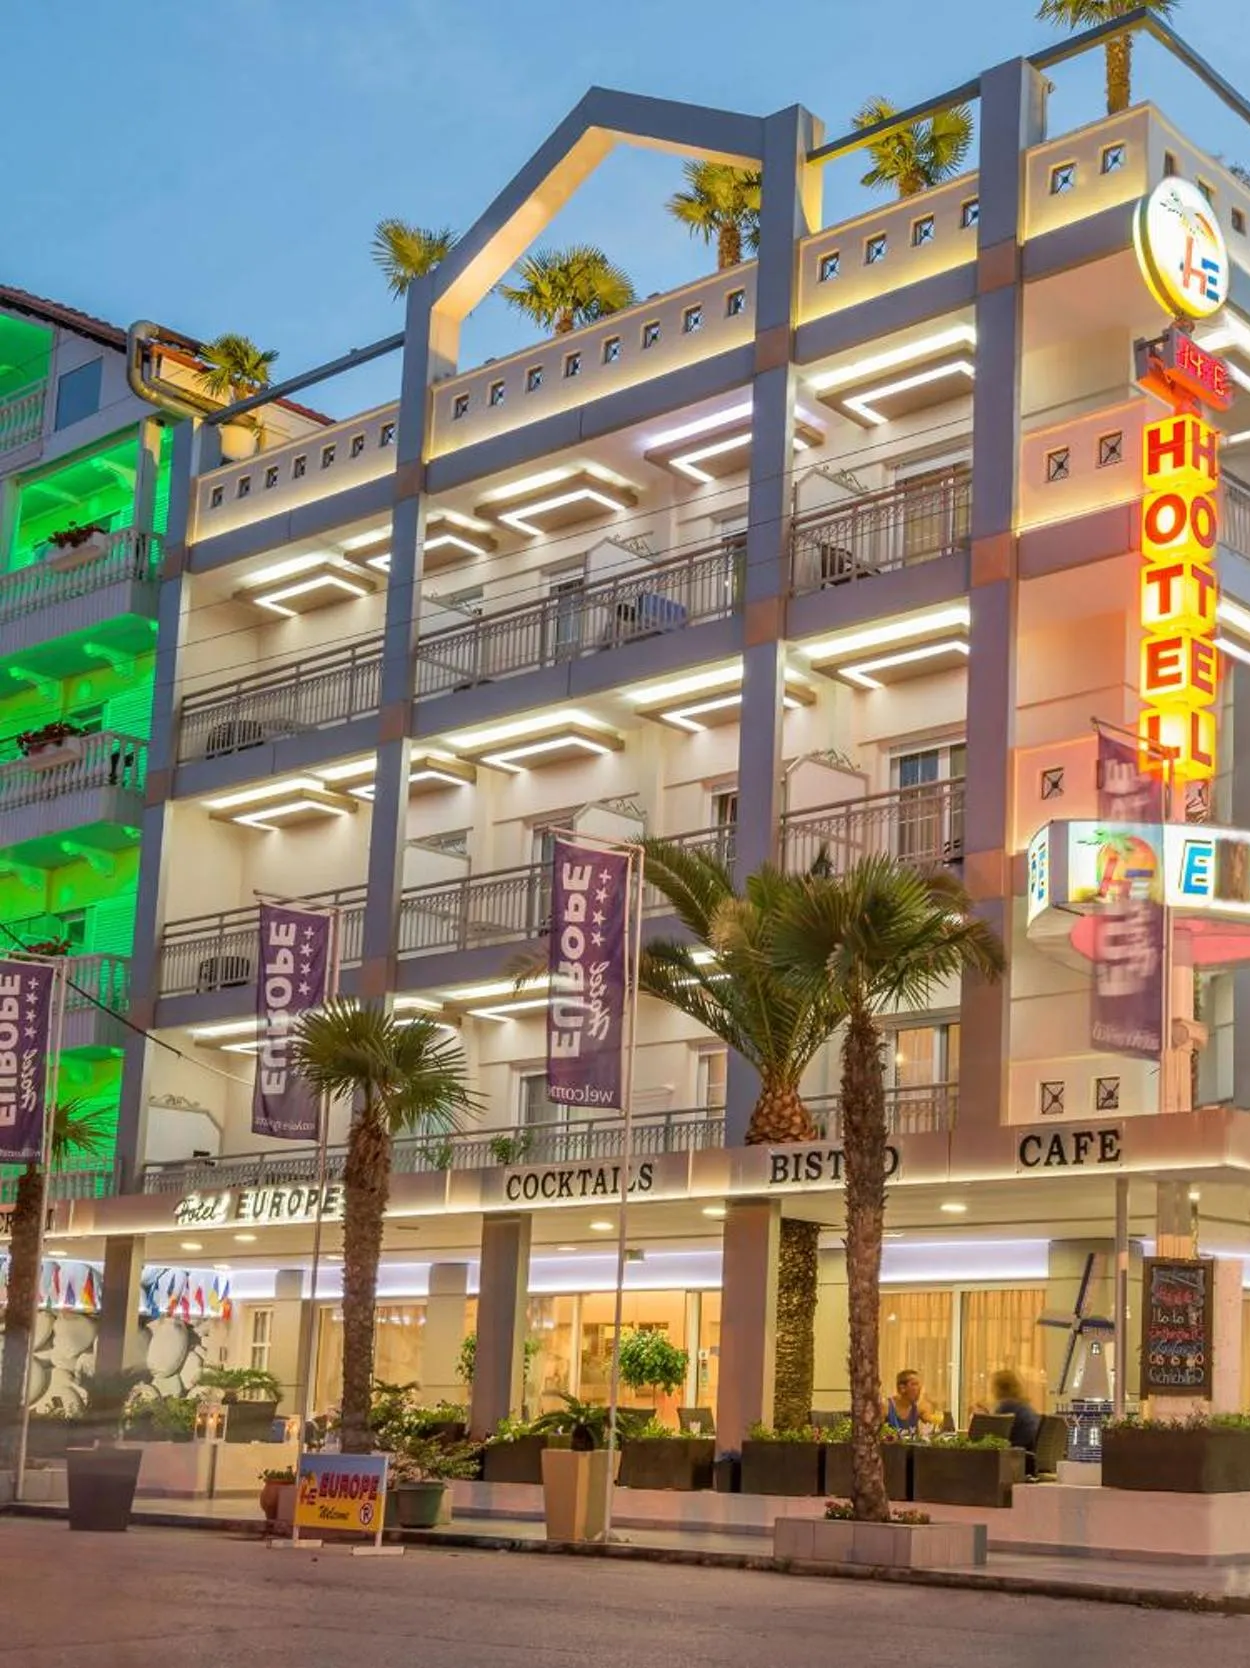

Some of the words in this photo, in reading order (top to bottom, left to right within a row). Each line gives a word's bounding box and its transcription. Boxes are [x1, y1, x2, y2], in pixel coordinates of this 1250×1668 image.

[1144, 420, 1187, 763] HOTEL
[1190, 420, 1217, 768] HOTEL
[769, 1146, 899, 1184] BISTO
[1019, 1129, 1121, 1168] CAFE
[176, 1197, 219, 1224] Hotel
[235, 1185, 342, 1219] EUROPE
[319, 1472, 380, 1500] EUROPE
